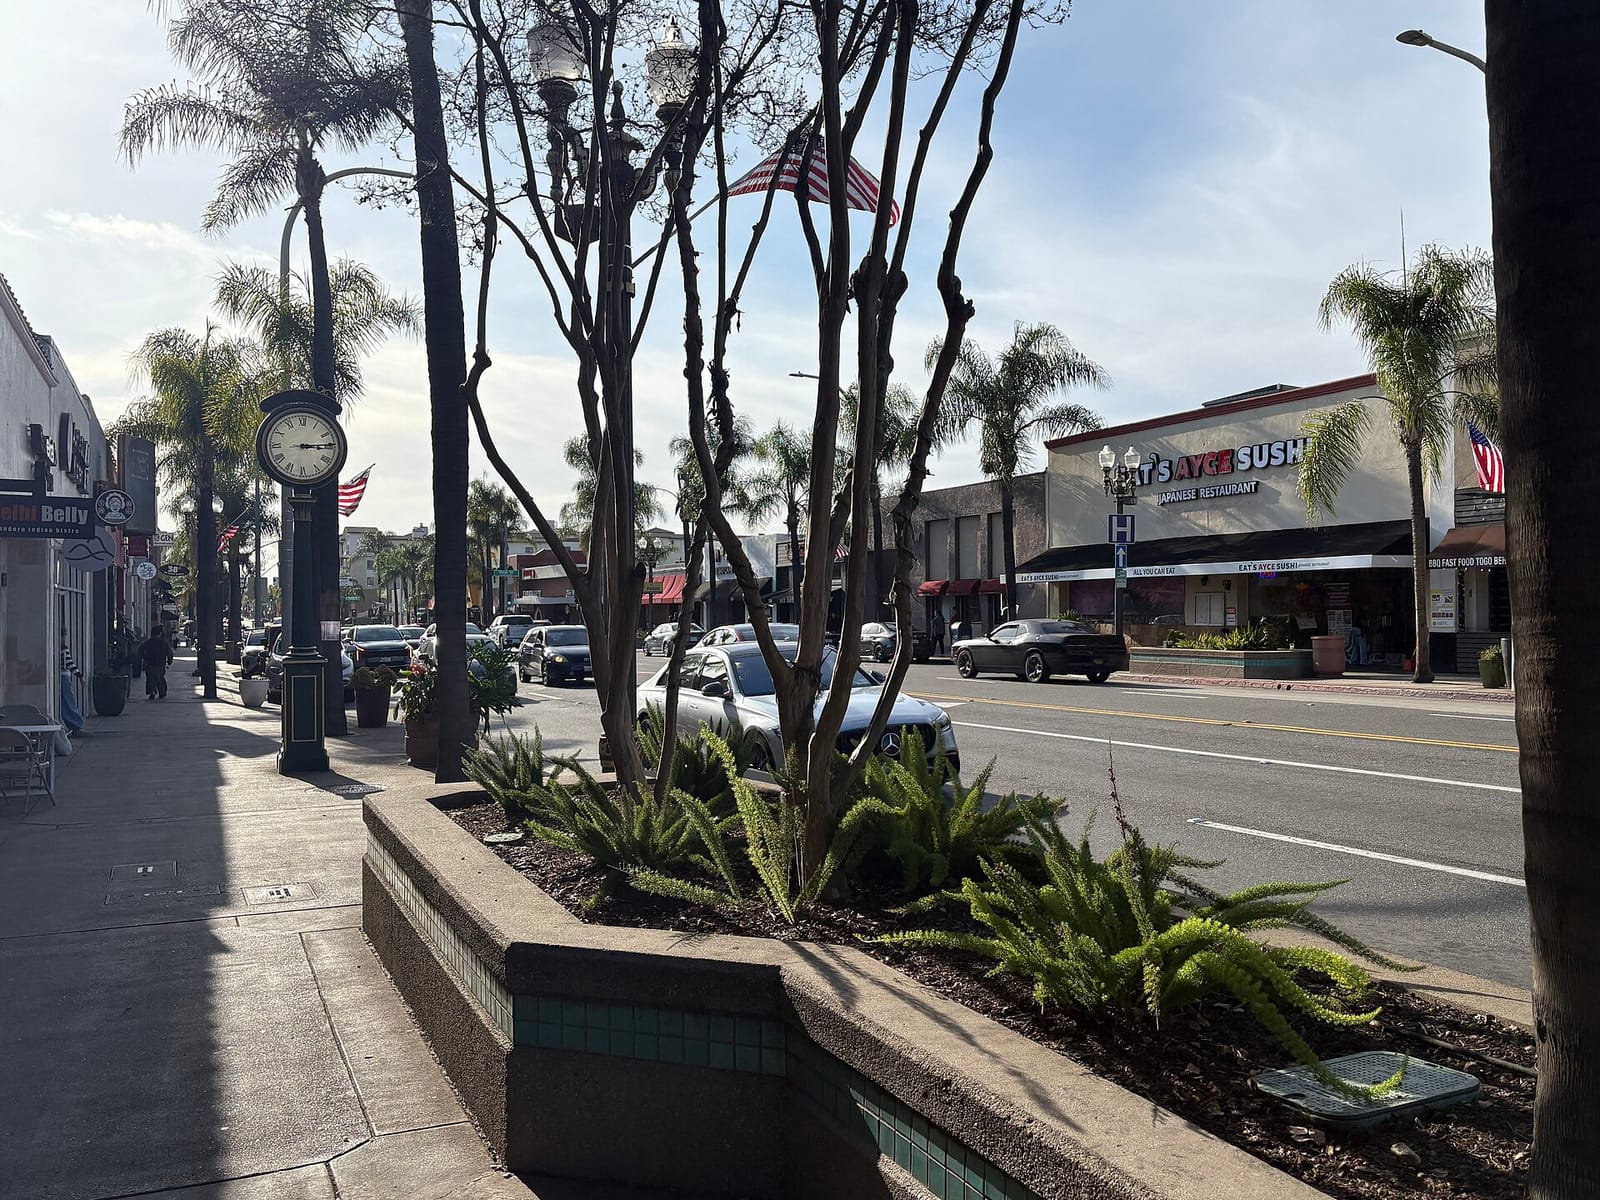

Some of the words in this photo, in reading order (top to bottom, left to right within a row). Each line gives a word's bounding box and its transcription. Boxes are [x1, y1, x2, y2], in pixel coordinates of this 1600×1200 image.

[1174, 449, 1235, 481] AYCE
[1157, 487, 1197, 505] JAPANESE
[1199, 481, 1259, 499] RESTAURANT
[0, 503, 37, 521] elhi
[41, 505, 89, 525] Belly
[1112, 516, 1131, 542] H
[1143, 568, 1154, 576] YOU
[1166, 567, 1175, 575] EAT
[1258, 562, 1276, 571] AYCE
[1276, 561, 1298, 570] SUSHI
[1428, 559, 1441, 568] BBQ
[1442, 558, 1457, 567] FAST
[1458, 557, 1475, 567] FOOD
